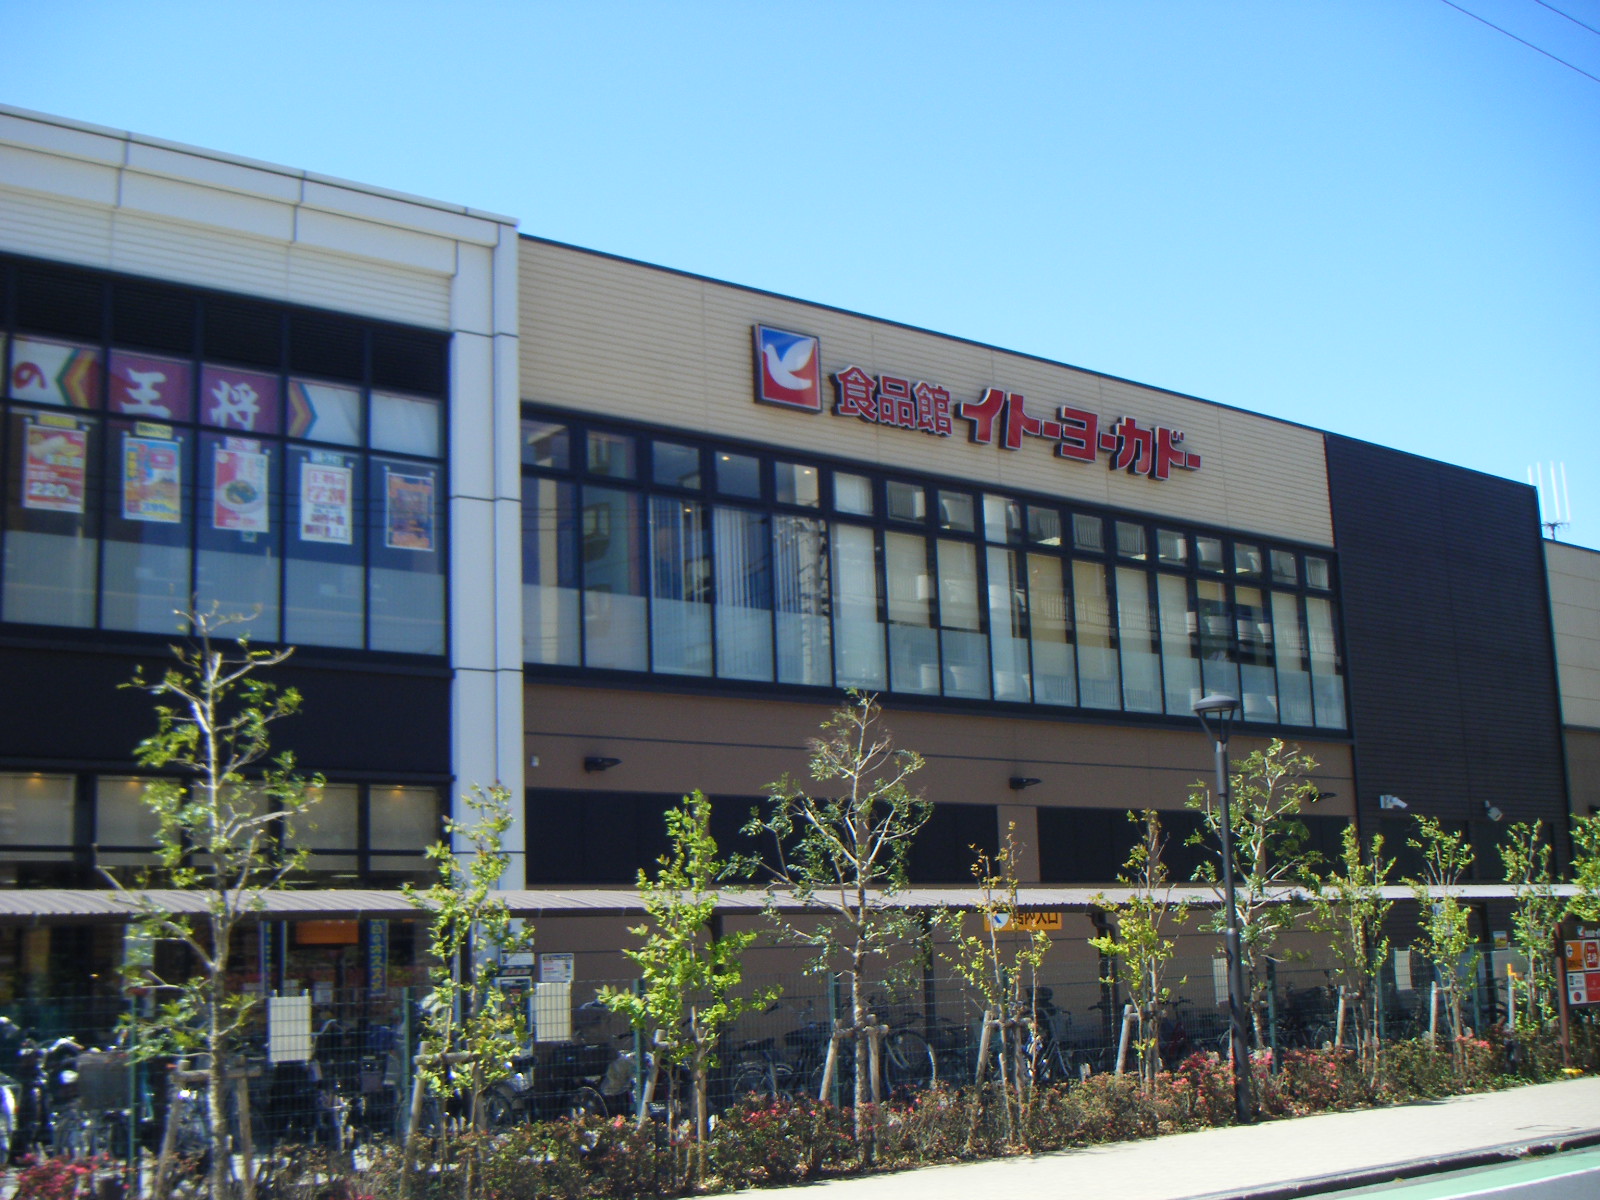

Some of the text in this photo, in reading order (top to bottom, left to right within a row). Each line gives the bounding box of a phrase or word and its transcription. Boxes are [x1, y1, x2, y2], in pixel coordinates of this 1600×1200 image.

[833, 365, 1201, 480] 食品館 イトーヨーカドー
